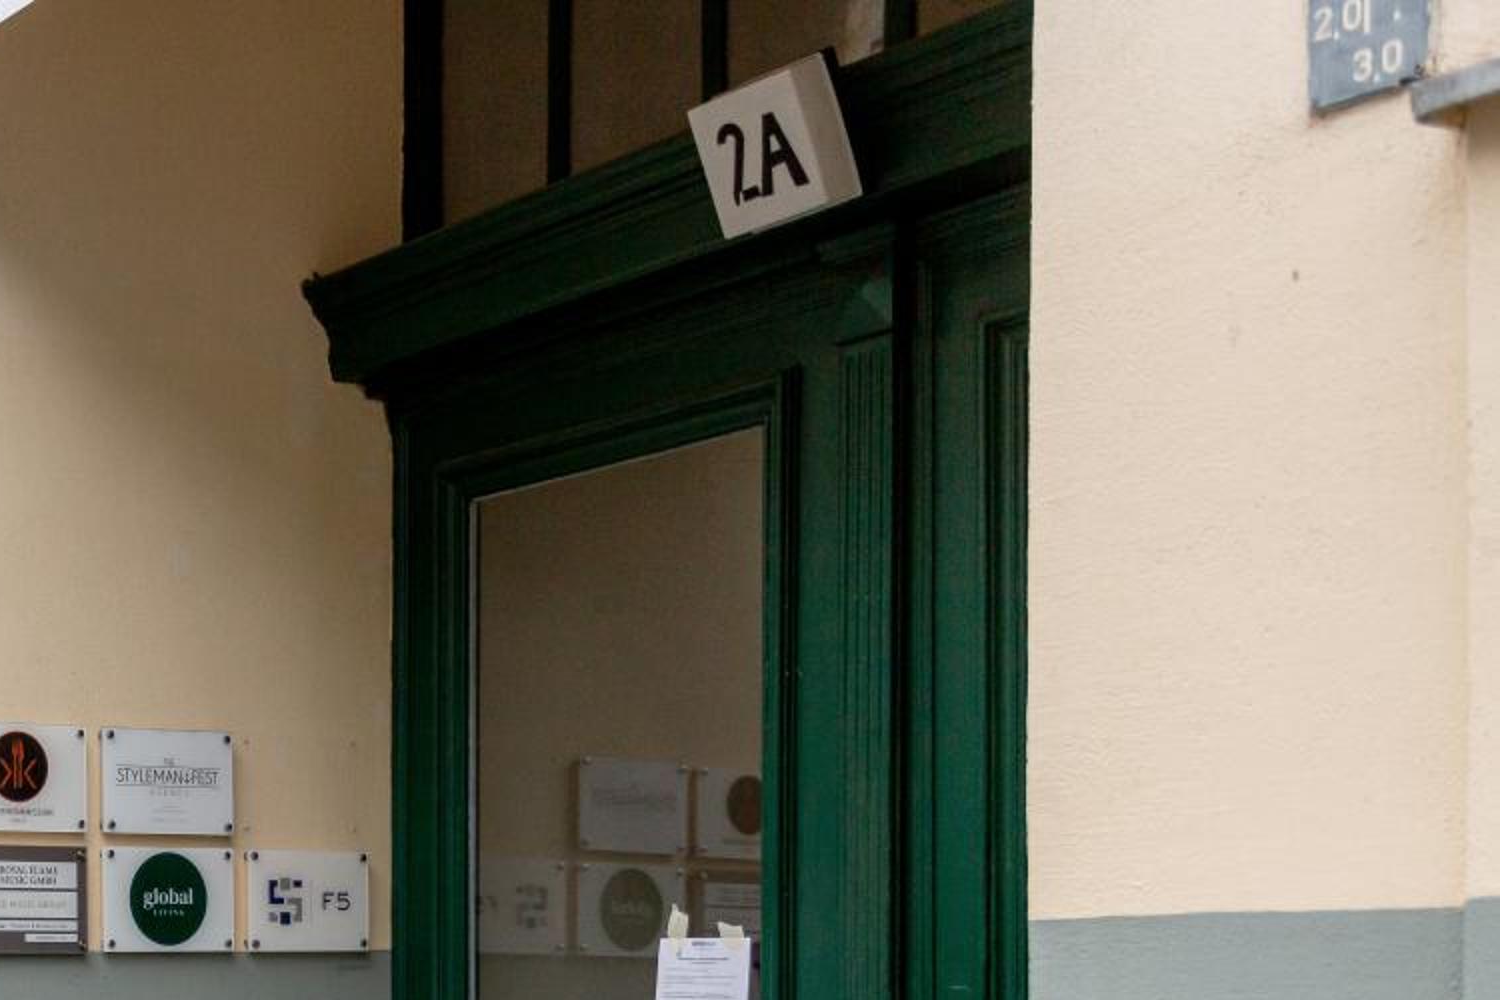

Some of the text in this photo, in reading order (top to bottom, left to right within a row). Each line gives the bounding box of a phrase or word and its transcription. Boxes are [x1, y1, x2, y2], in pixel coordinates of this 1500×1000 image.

[716, 111, 810, 207] 2A
[142, 887, 194, 911] global
[322, 891, 352, 912] F5
